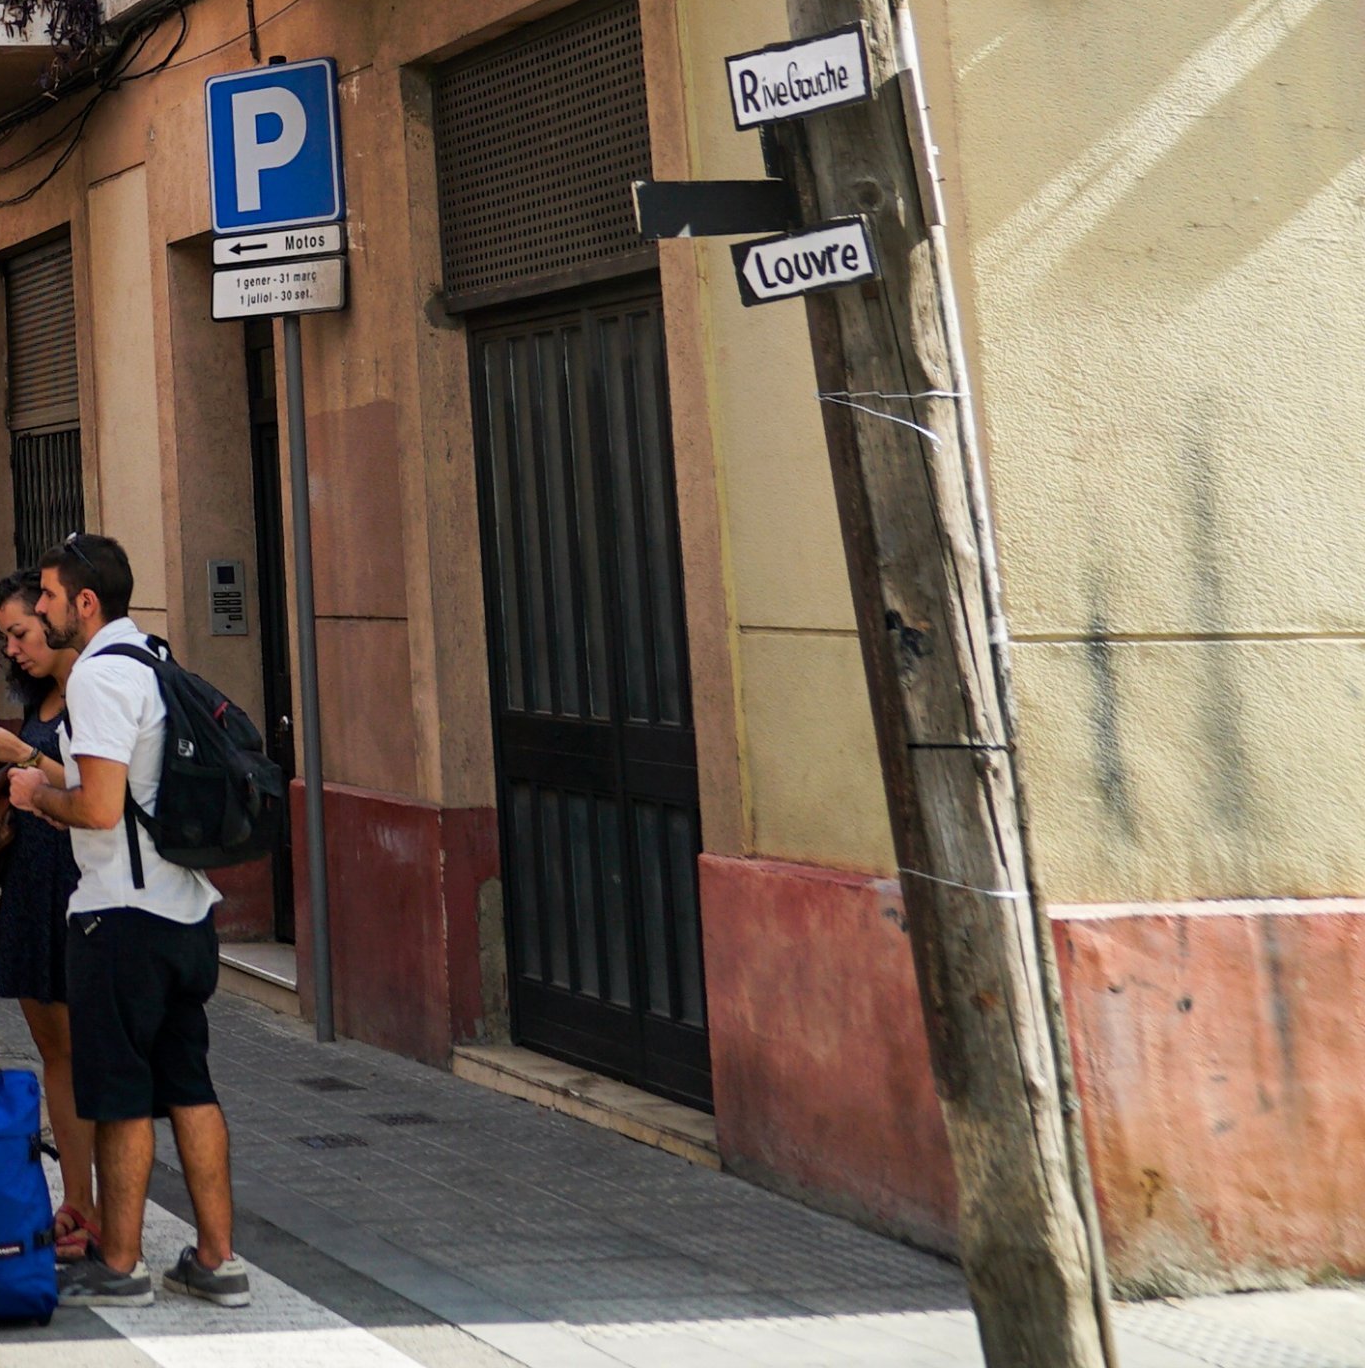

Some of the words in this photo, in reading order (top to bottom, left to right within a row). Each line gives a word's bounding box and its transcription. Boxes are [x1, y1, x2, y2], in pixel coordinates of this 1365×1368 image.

[231, 86, 307, 212] P
[285, 235, 325, 251] Motos
[754, 243, 859, 288] Louvre
[236, 278, 241, 288] 1
[244, 276, 271, 290] gener
[279, 273, 290, 284] 31
[240, 295, 245, 305] 1
[247, 292, 272, 306] juliol
[280, 291, 292, 302] 30
[294, 289, 313, 301] set.
